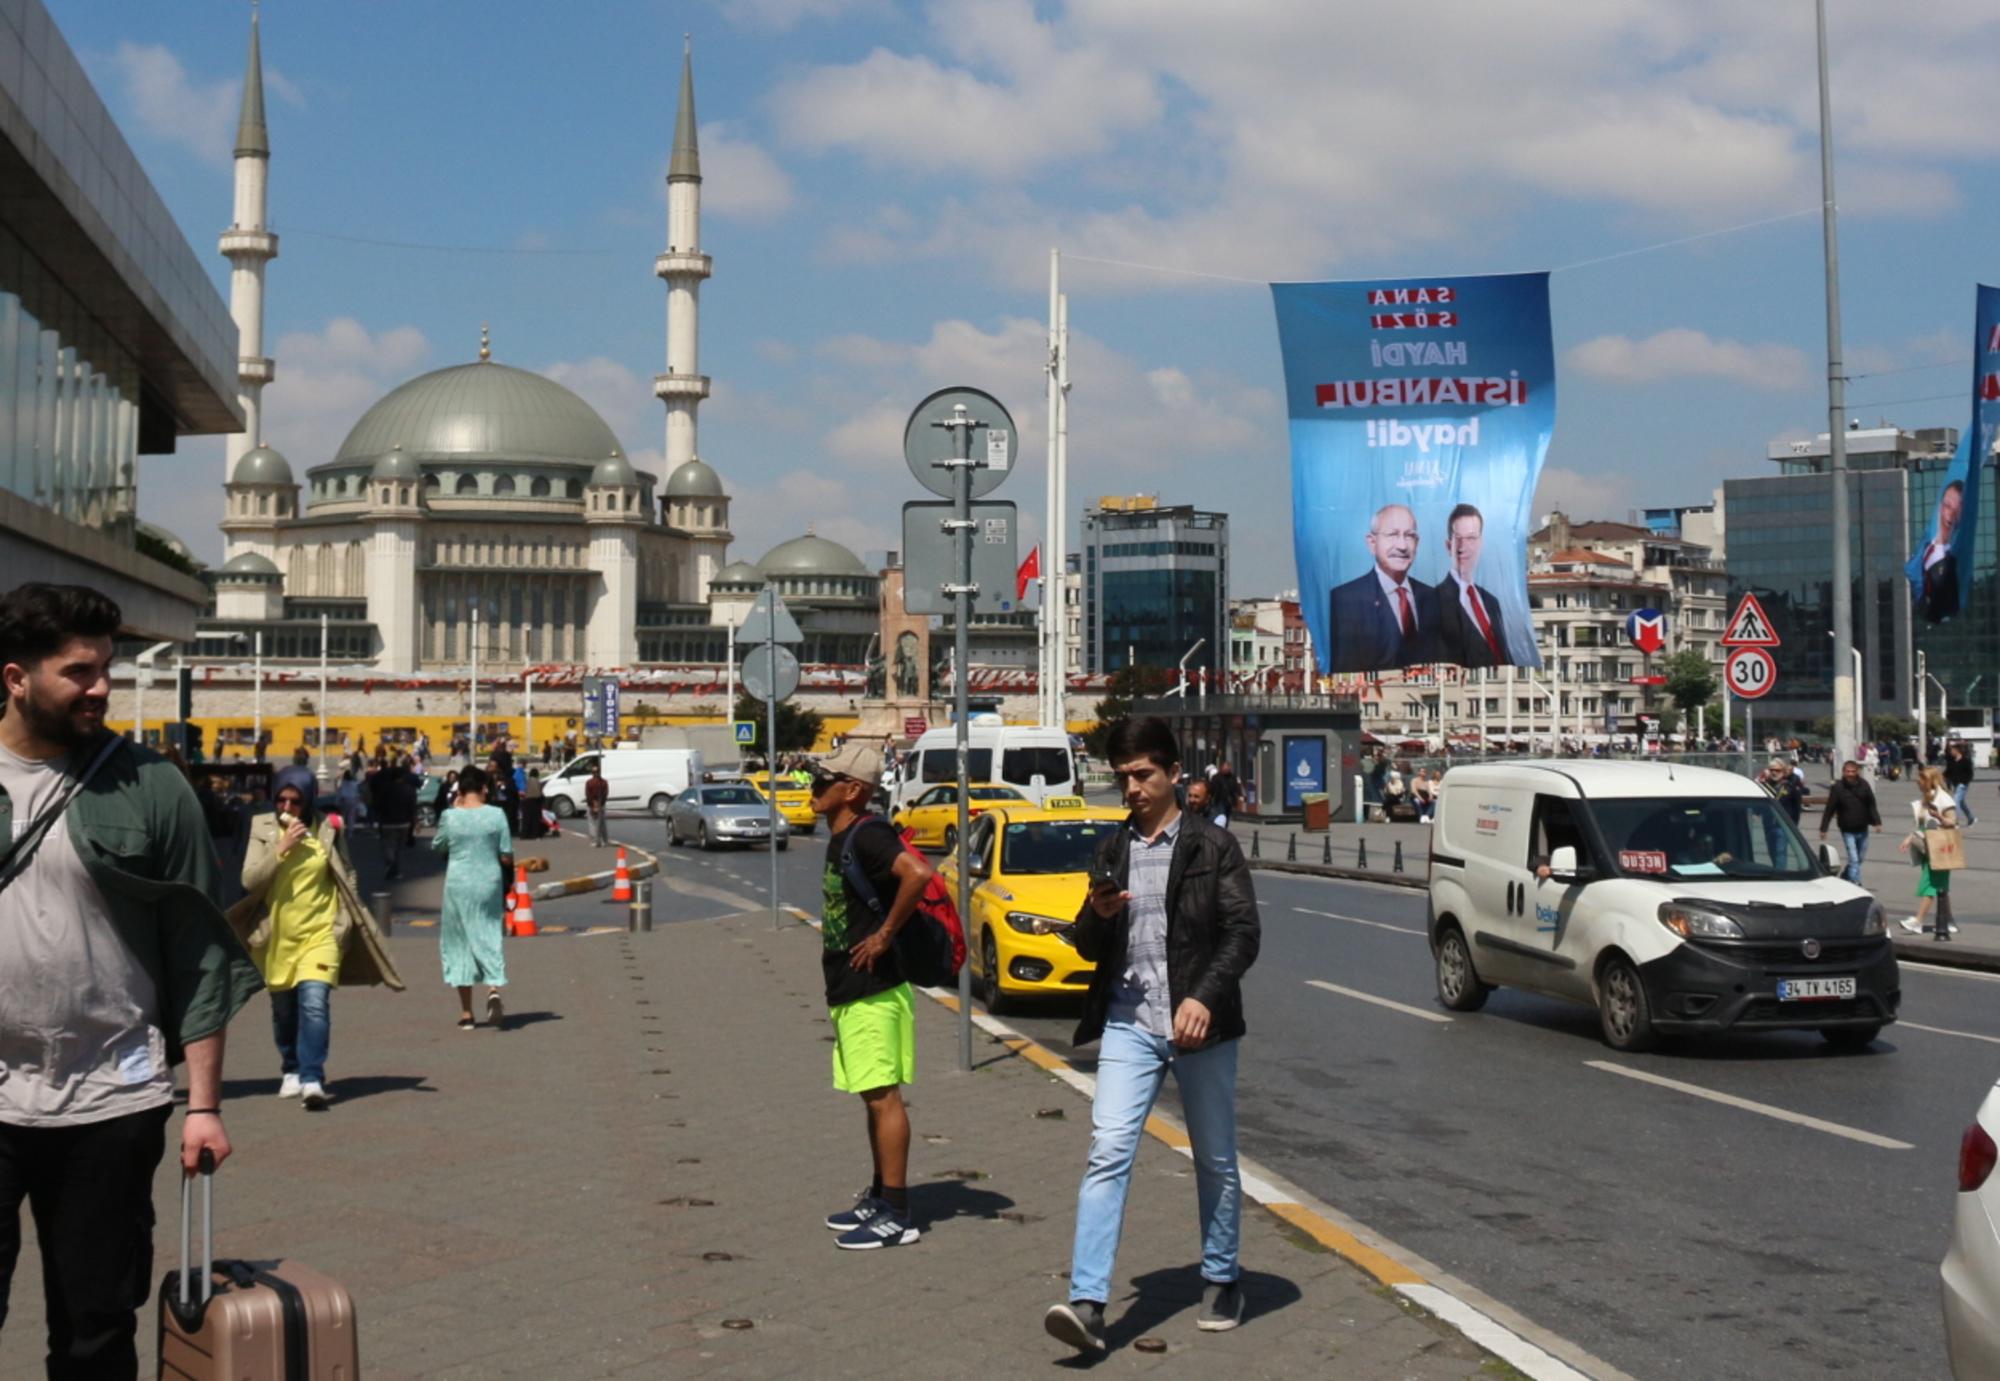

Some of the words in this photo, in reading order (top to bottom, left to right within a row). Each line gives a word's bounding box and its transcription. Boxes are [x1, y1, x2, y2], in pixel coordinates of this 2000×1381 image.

[1736, 660, 1764, 683] 30
[1786, 982, 1800, 996] 34
[1806, 981, 1819, 995] TV
[1825, 980, 1852, 993] 4165
